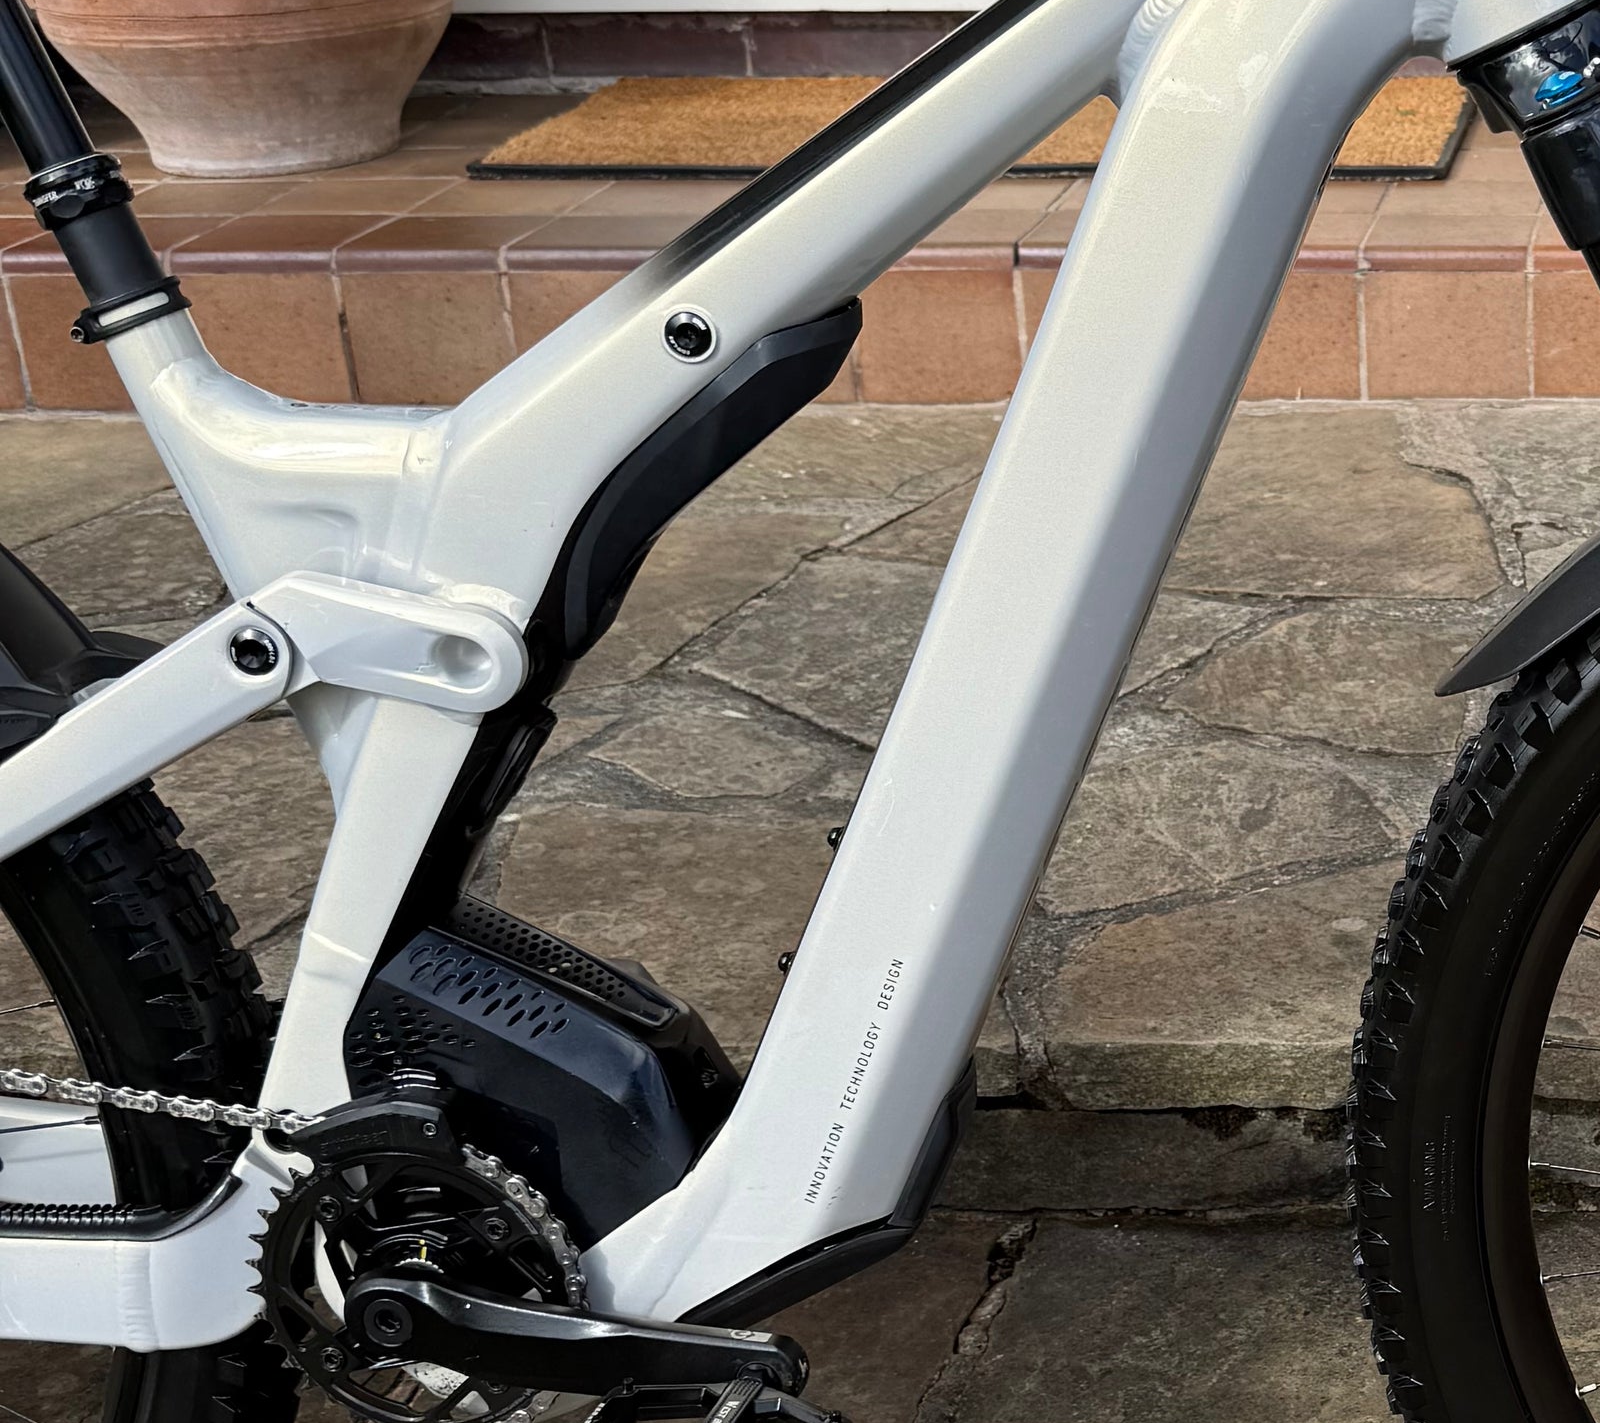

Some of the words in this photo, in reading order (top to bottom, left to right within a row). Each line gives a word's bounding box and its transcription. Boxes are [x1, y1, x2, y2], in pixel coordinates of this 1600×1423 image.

[804, 1122, 845, 1204] INNOVATION
[839, 1021, 881, 1110] TECHNOLOGY
[876, 958, 904, 1010] DESIGN
